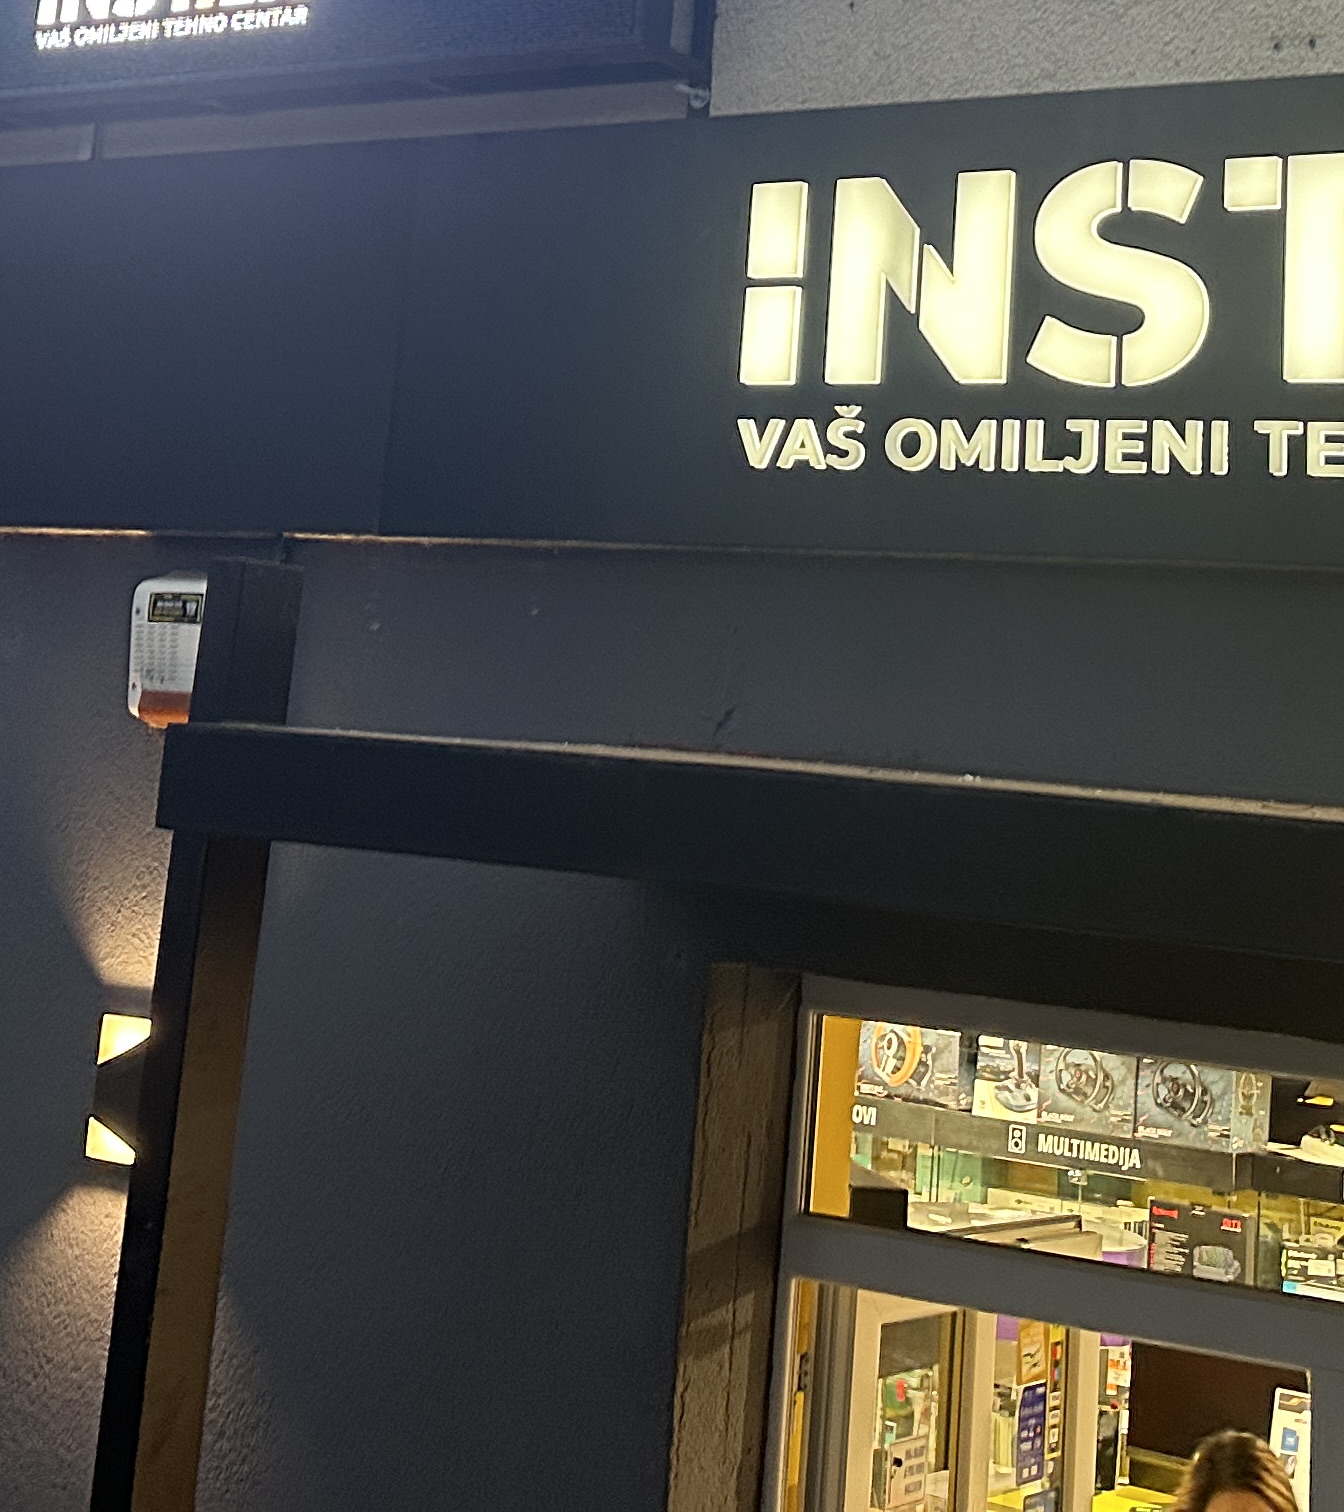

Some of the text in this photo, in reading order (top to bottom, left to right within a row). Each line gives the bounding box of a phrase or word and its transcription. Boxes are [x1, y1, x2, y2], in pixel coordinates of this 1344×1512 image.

[73, 18, 160, 47] OMILJENI
[162, 12, 229, 38] TEHNO
[230, 4, 308, 31] CENTAR
[737, 405, 868, 471] VAŠ
[883, 418, 1230, 475] OMILJENI
[1037, 1133, 1142, 1171] MULTIMEDIJA
